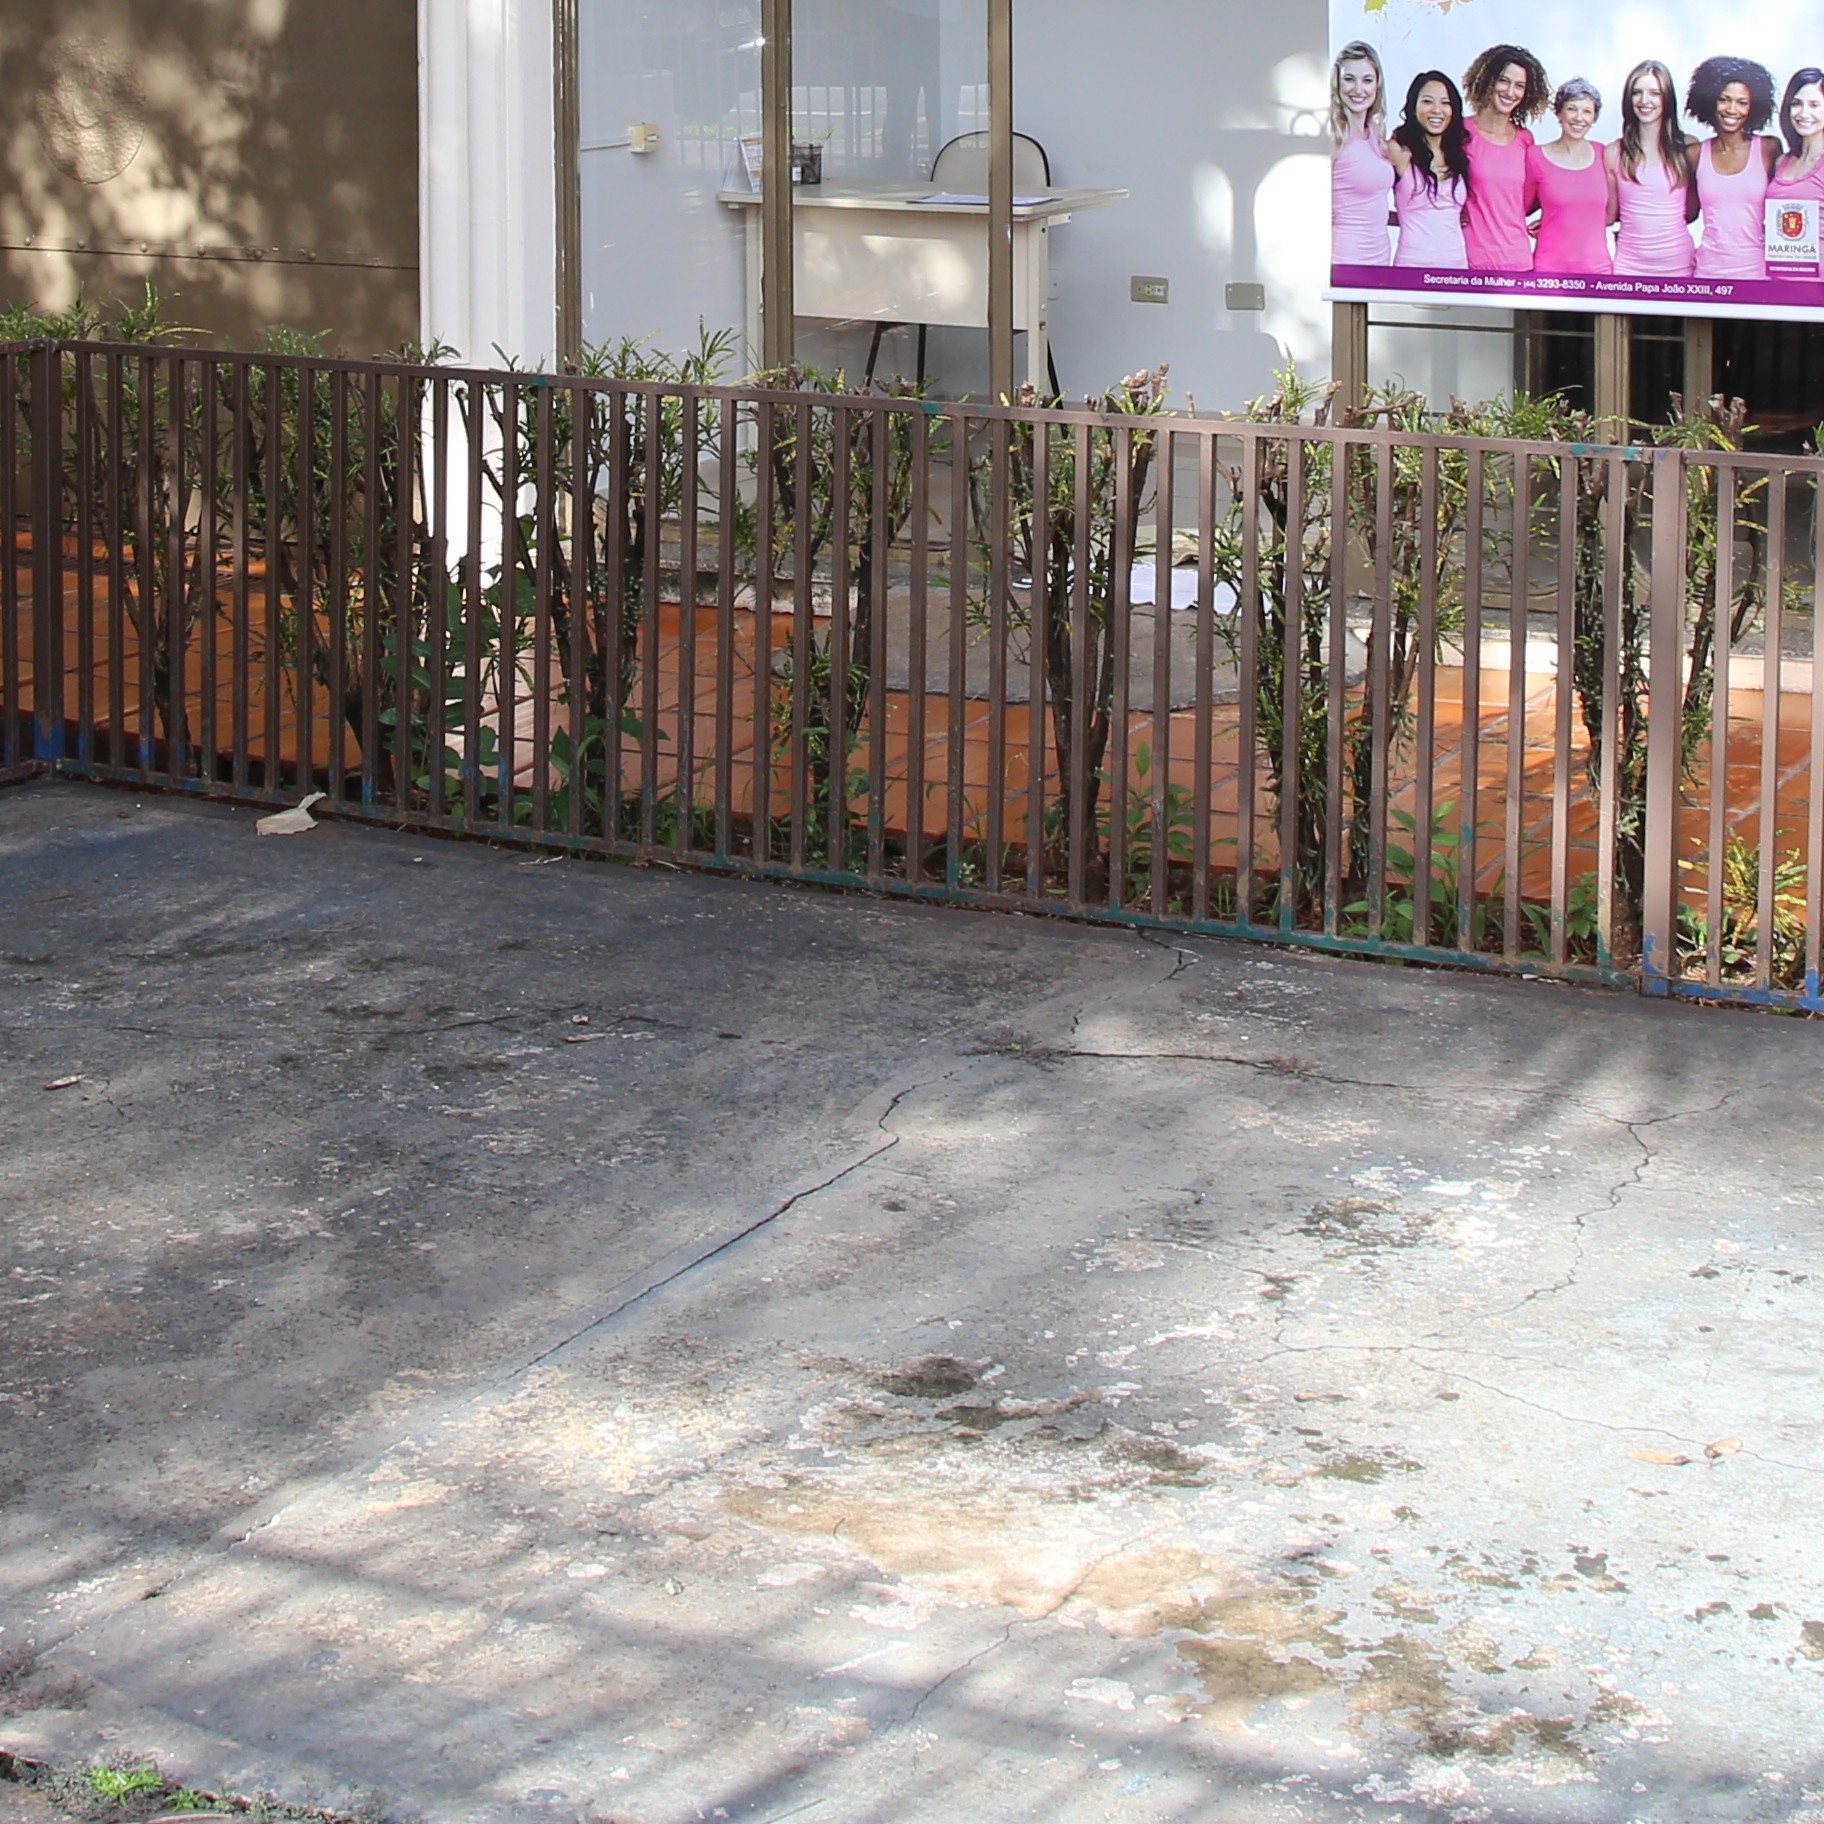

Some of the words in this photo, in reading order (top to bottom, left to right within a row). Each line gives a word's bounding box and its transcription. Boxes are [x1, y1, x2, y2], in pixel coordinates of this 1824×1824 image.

[1768, 243, 1816, 253] MARINGÁ
[1423, 273, 1469, 285] Secretaria
[1470, 276, 1483, 286] da
[1484, 276, 1515, 287] Mulher
[1536, 278, 1586, 289] 3293-8350
[1595, 281, 1633, 292] Avenida
[1634, 283, 1660, 294] Papa
[1661, 284, 1685, 294] João
[1714, 286, 1734, 295] 497
